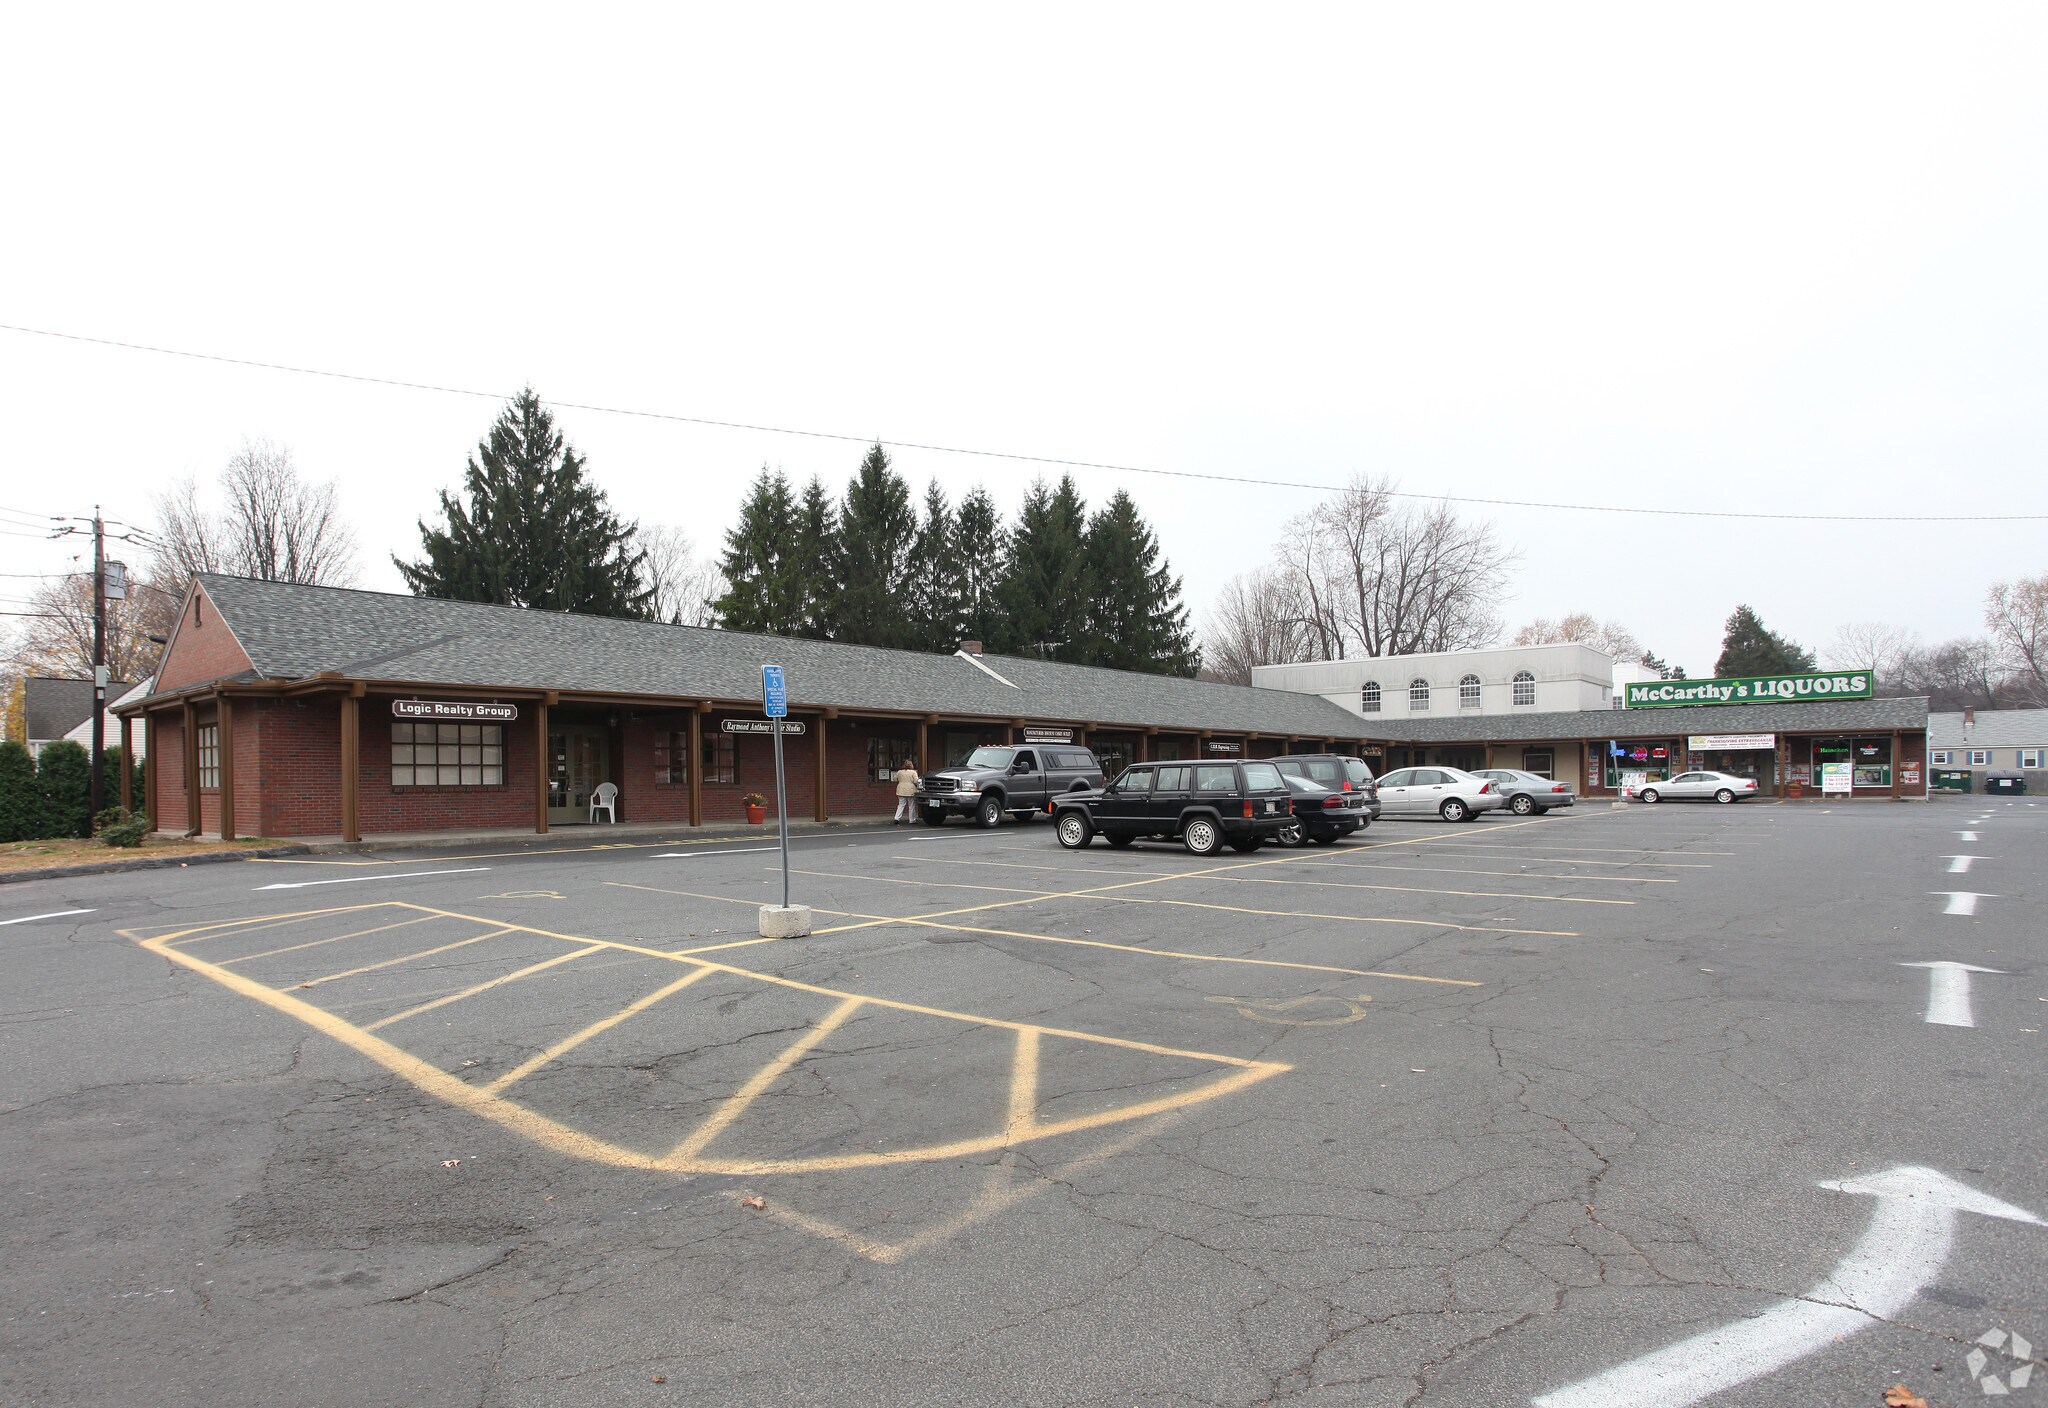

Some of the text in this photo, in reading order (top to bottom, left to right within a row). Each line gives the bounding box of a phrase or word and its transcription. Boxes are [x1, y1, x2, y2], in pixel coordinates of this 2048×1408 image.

[1631, 676, 1867, 701] McCarthy's LIQUORS
[400, 703, 511, 717] Logic Realty Group
[726, 722, 750, 731] Raymond
[750, 723, 773, 732] Anthony's
[785, 724, 801, 732] Studio
